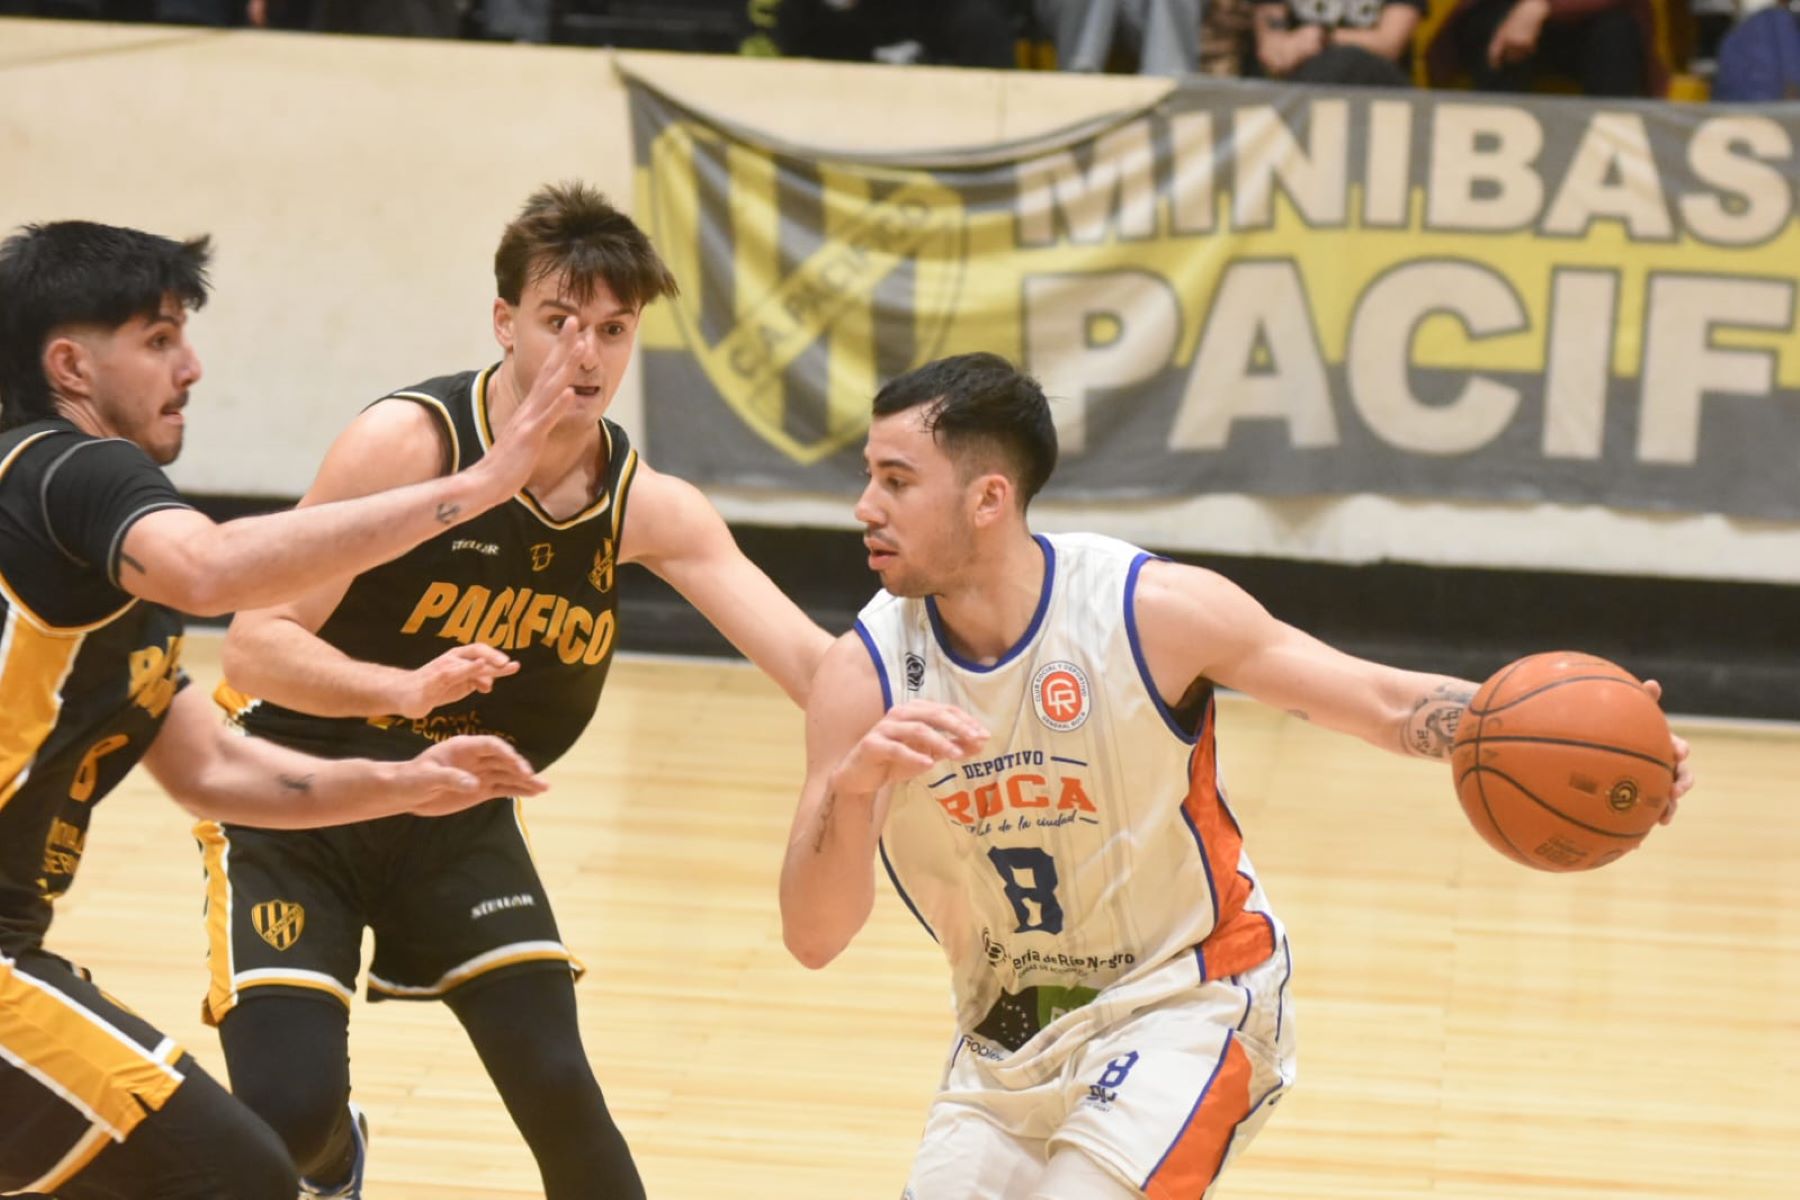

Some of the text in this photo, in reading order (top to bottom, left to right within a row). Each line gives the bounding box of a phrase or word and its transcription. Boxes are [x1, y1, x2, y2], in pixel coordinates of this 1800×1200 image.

[400, 580, 616, 667] PACIFICO
[961, 750, 1044, 779] DEPOTIVO
[935, 774, 1098, 825] ROCA
[987, 845, 1064, 936] 8
[1097, 1049, 1141, 1089] 8
